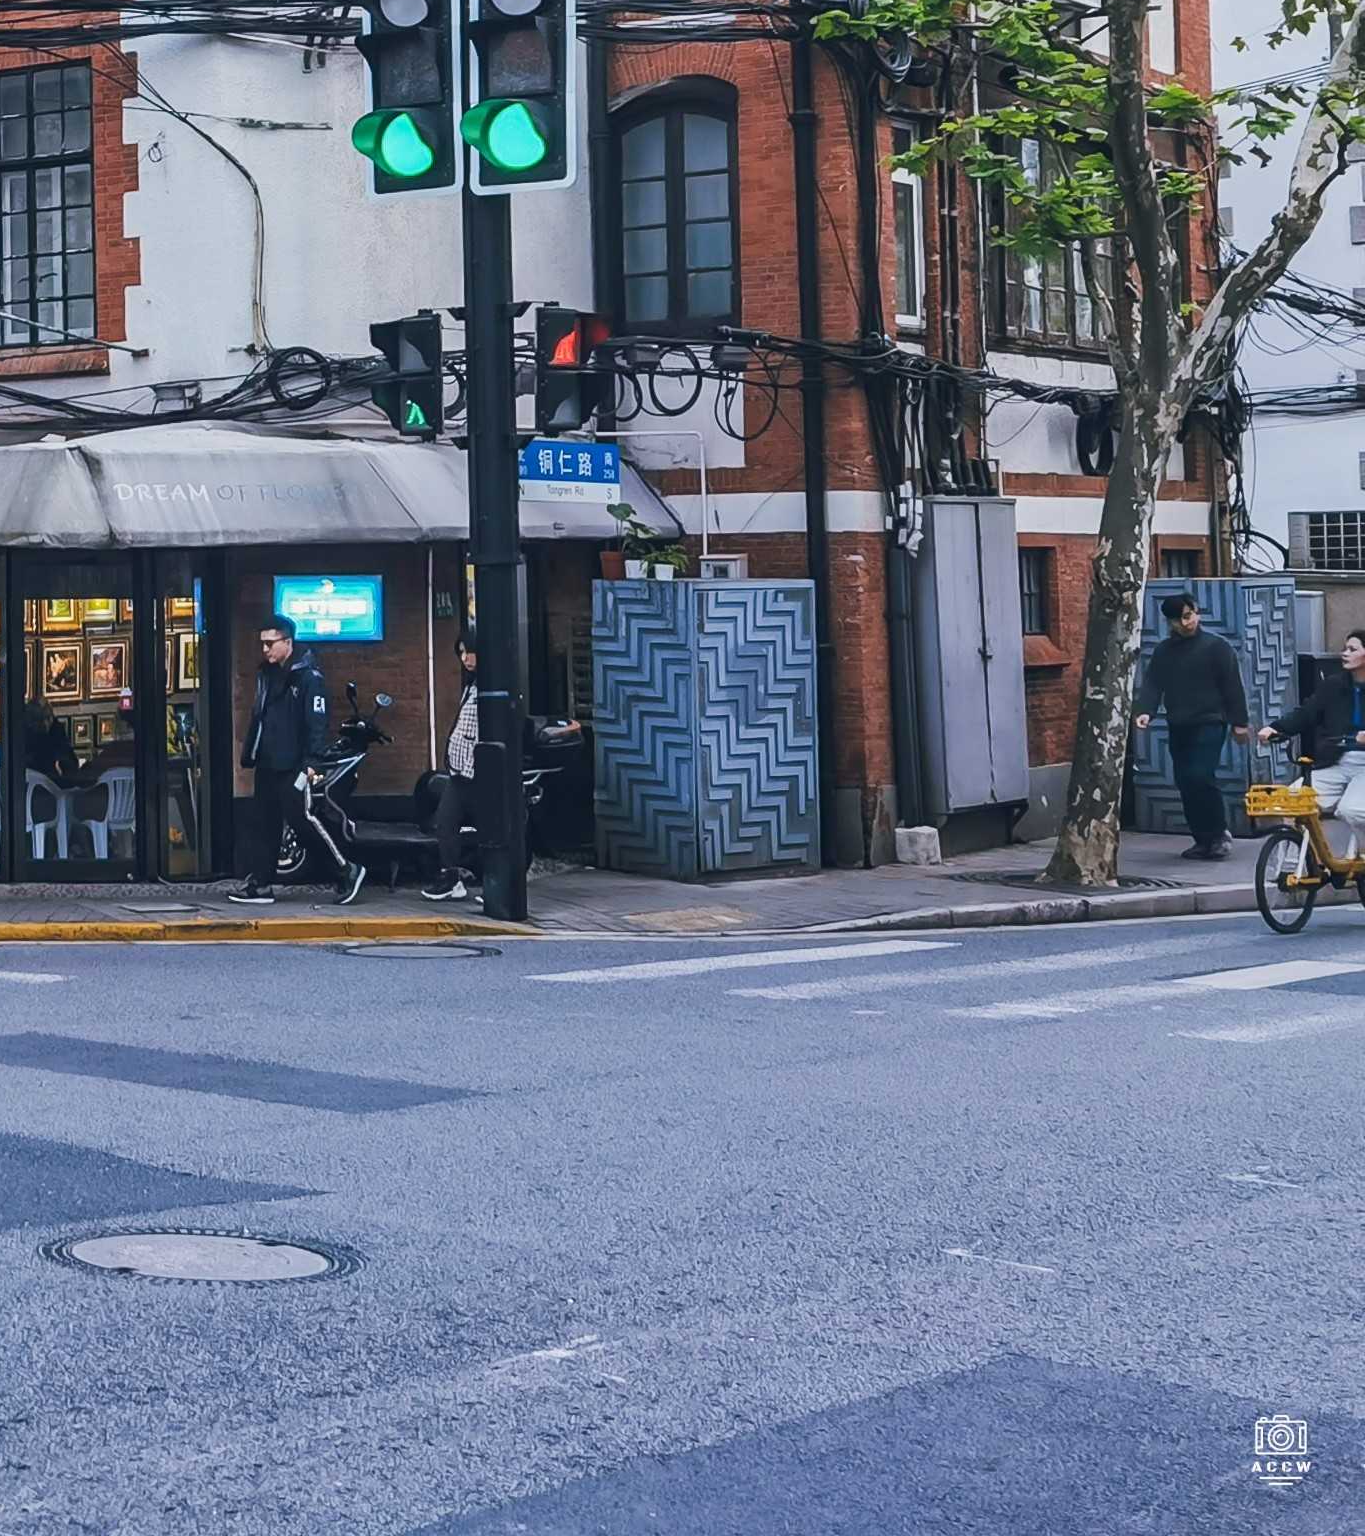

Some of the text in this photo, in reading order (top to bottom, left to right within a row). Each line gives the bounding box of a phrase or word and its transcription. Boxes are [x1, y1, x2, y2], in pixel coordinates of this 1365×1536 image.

[538, 449, 592, 476] 铜仁路
[113, 482, 210, 502] DREAM
